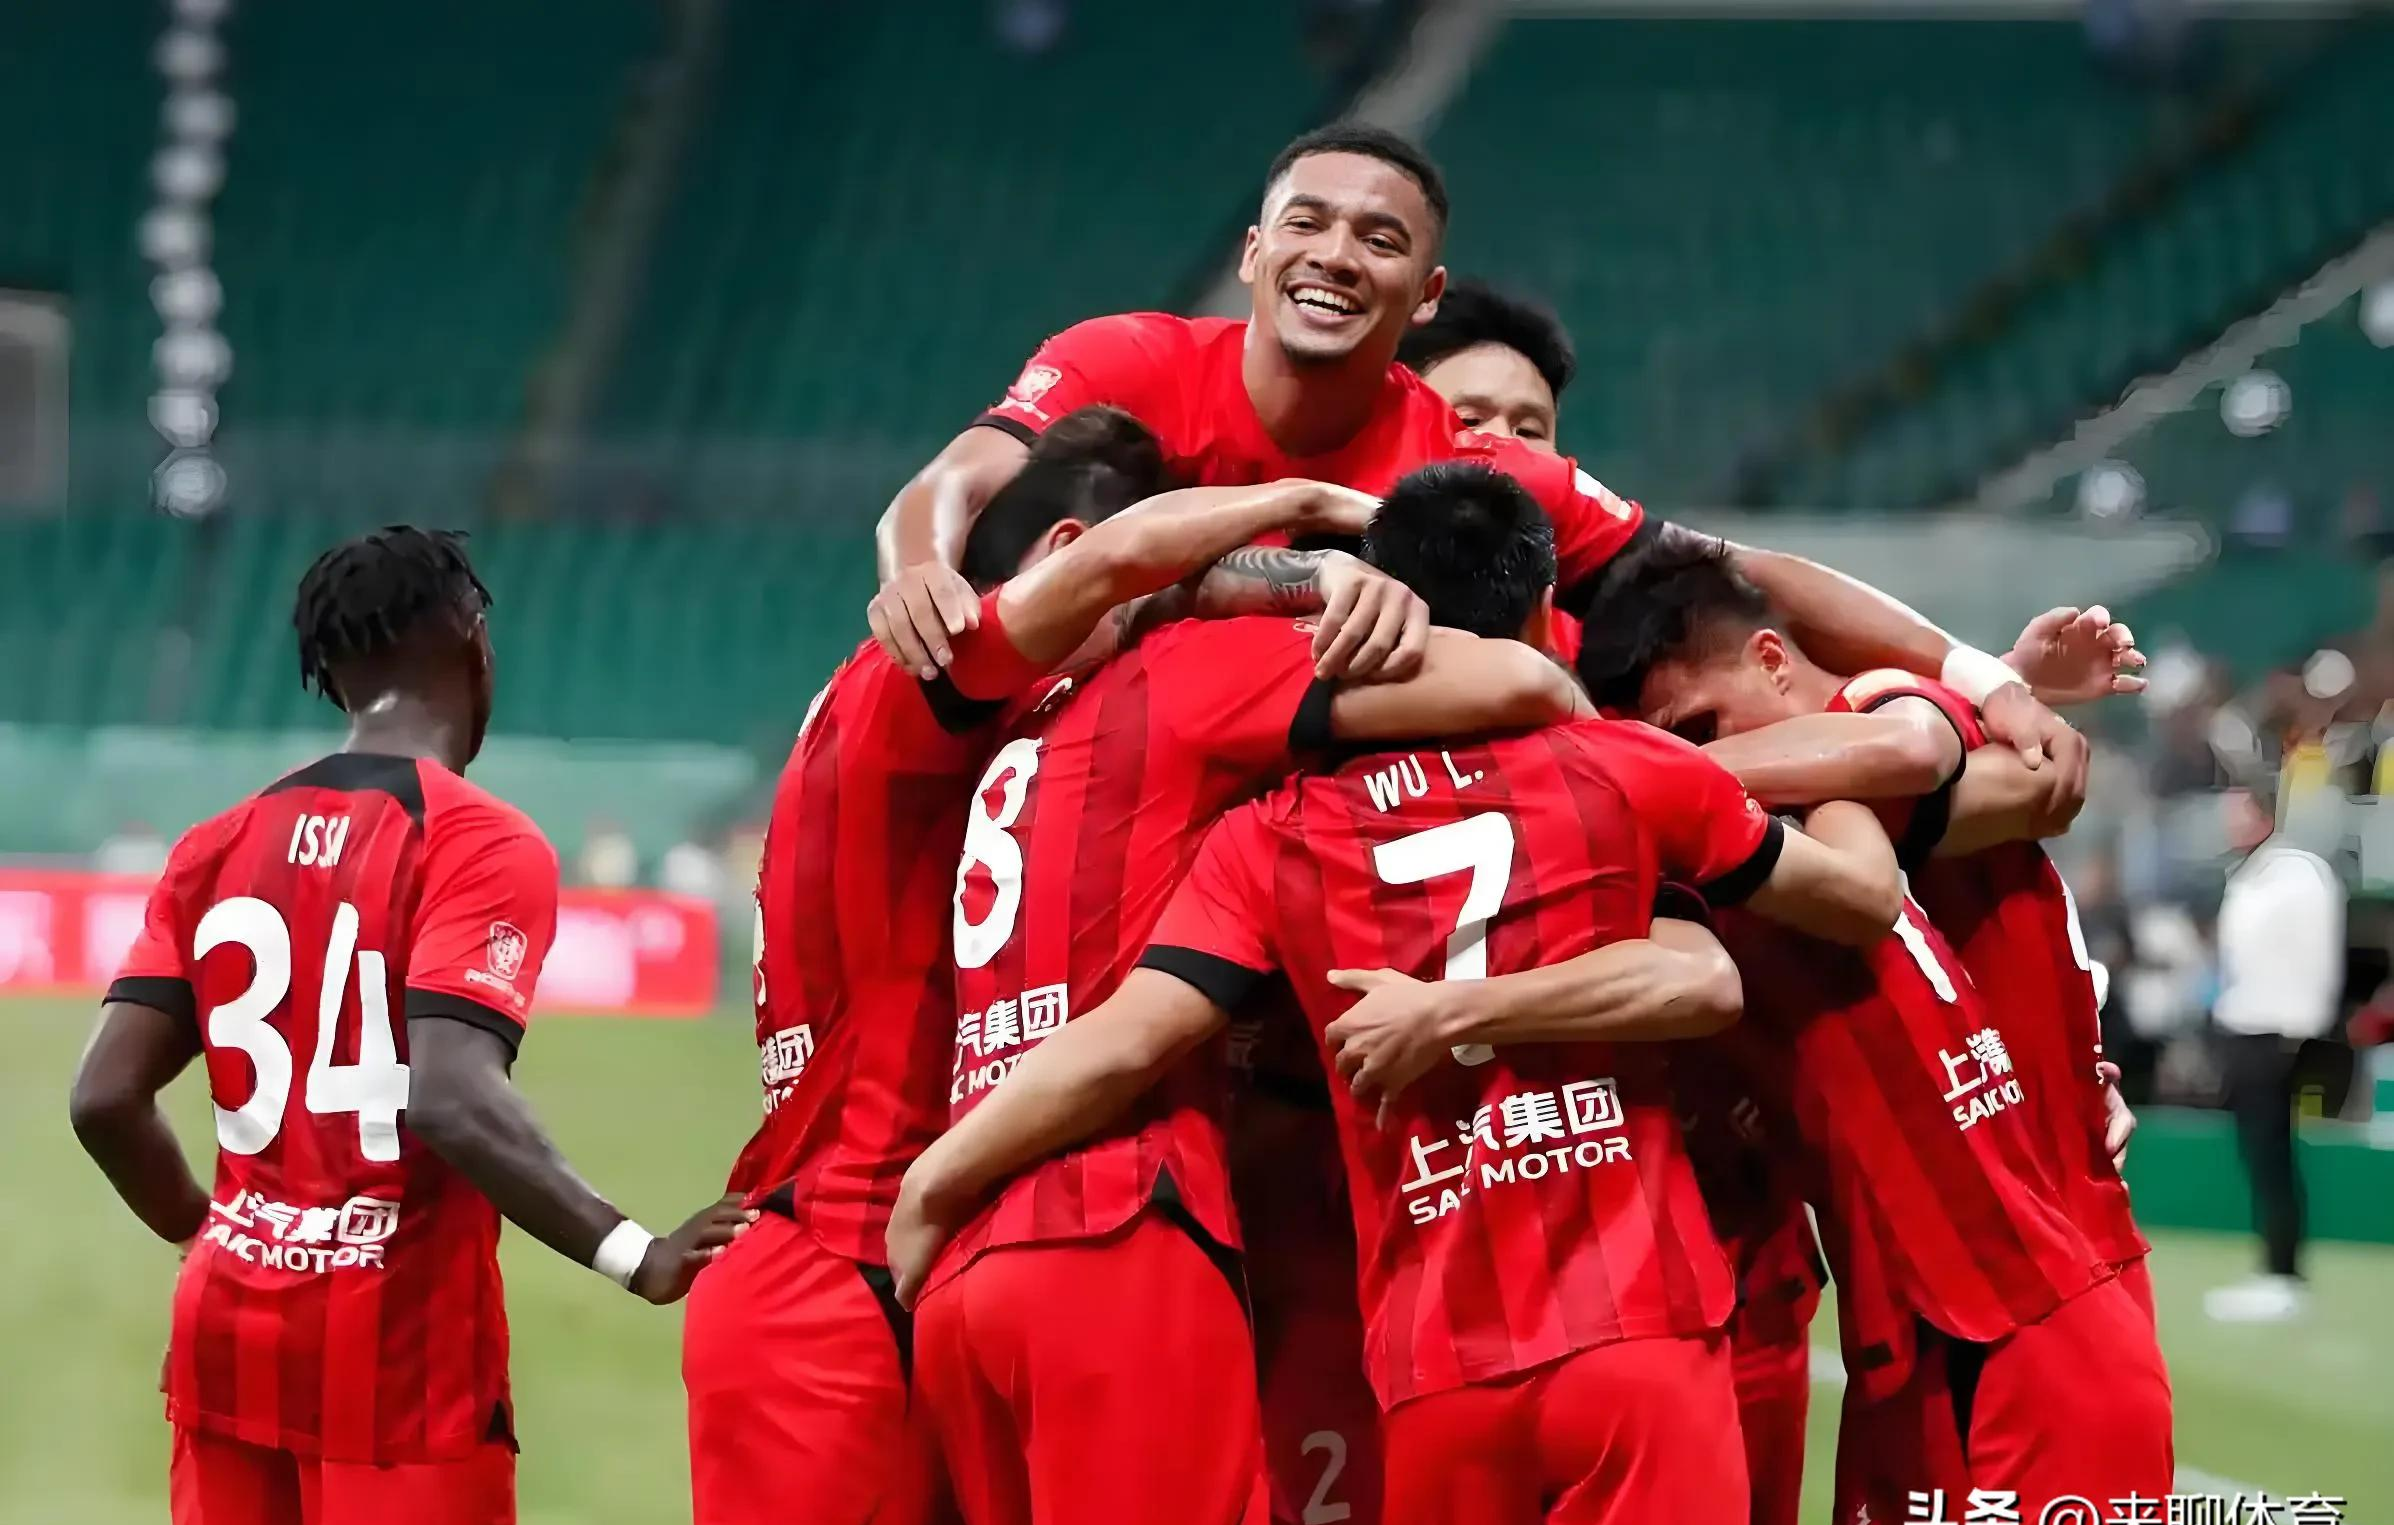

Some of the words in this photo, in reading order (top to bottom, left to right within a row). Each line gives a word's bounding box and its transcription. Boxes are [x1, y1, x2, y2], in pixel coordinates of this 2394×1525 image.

[1363, 754, 1428, 812] WU
[1441, 750, 1485, 790] L.
[953, 737, 1045, 969] 8
[1373, 811, 1515, 1066] 7
[193, 896, 410, 1162] 34
[953, 982, 1068, 1076] 汽集团
[1401, 1076, 1625, 1194] 上汽集团
[1481, 1136, 1633, 1189] MOTOR
[203, 1217, 264, 1262] AIC
[261, 1245, 385, 1274] MOTOR
